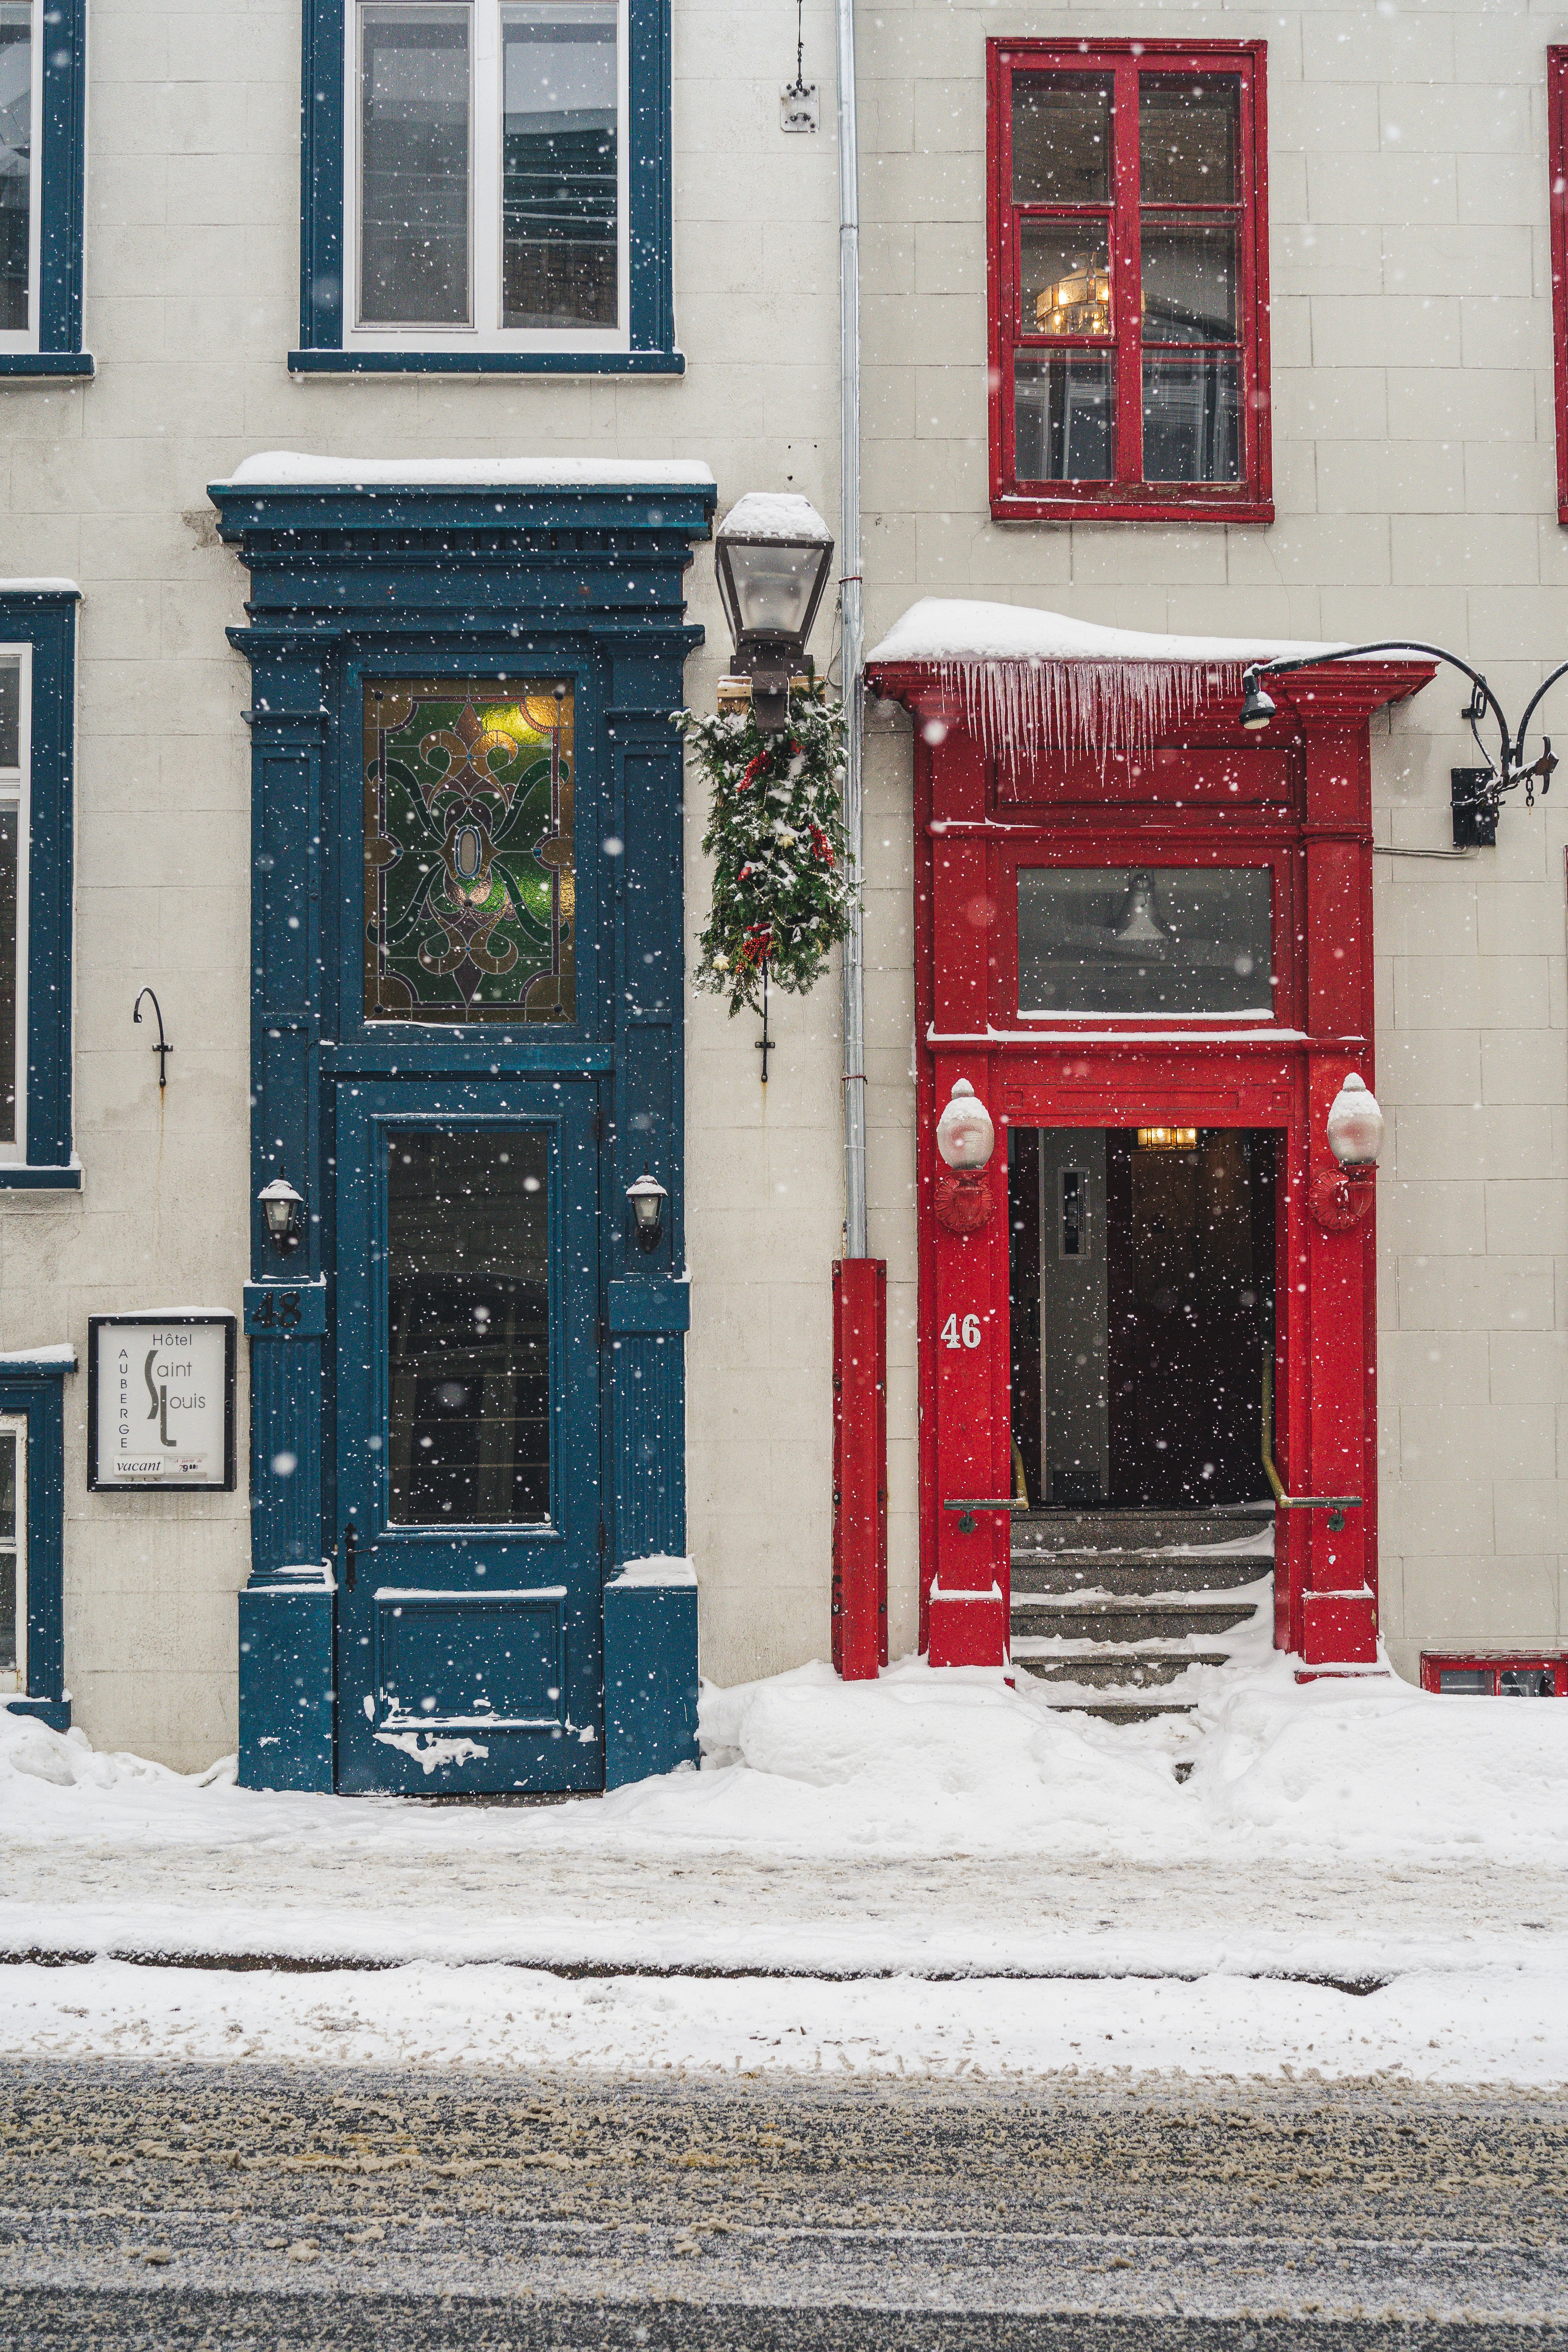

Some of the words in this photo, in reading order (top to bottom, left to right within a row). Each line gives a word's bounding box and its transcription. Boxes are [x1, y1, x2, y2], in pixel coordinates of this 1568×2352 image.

[252, 1291, 301, 1328] 48
[153, 1333, 192, 1346] Hôtel
[940, 1314, 981, 1348] 46
[119, 1349, 129, 1448] AUBERGE
[144, 1350, 192, 1419] Saint
[160, 1385, 205, 1447] Louis
[117, 1461, 161, 1471] vacant
